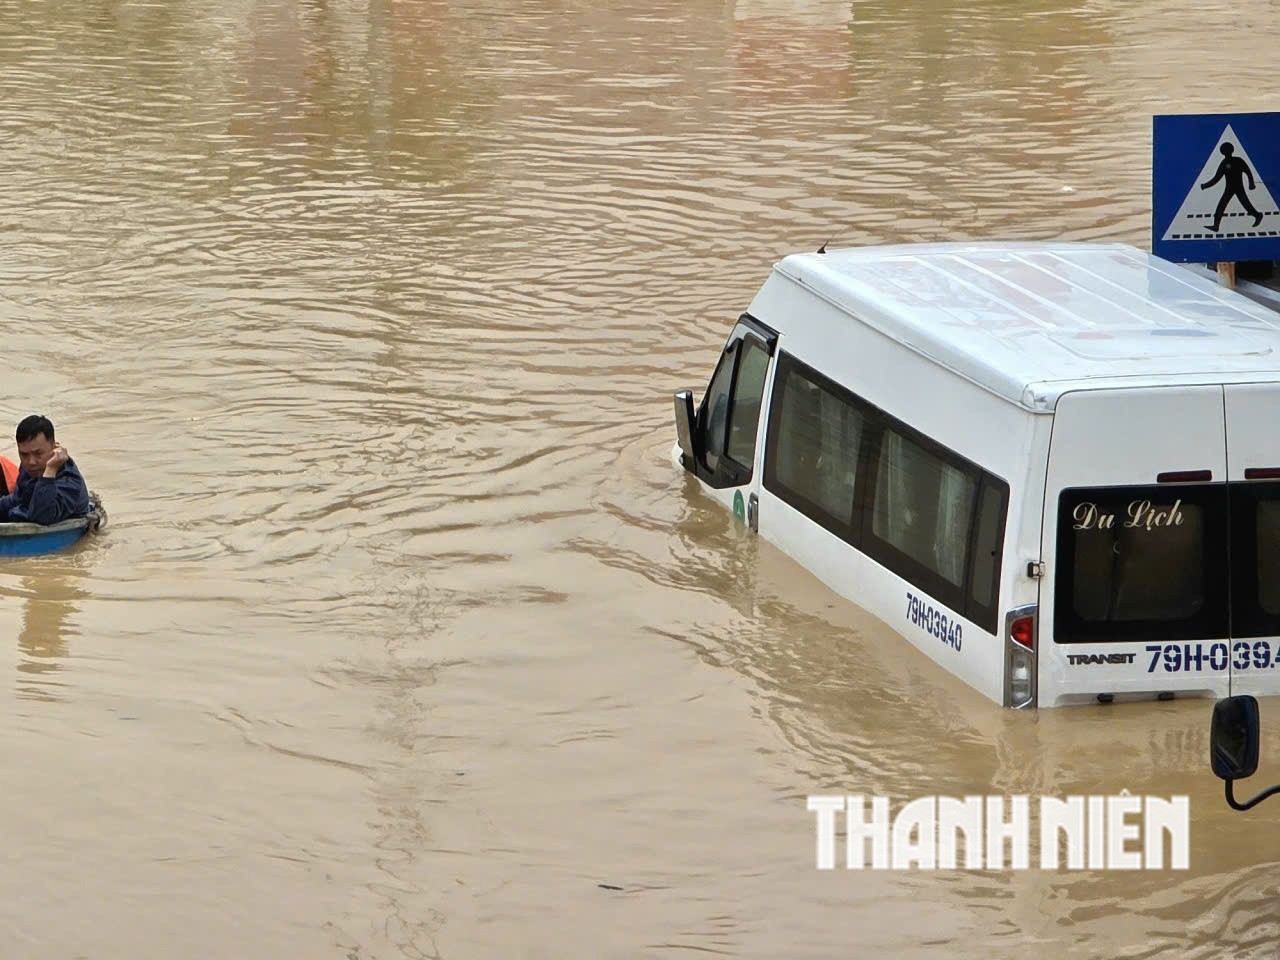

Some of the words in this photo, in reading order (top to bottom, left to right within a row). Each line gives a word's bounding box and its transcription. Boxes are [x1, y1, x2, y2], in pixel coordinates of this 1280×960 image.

[1072, 502, 1115, 530] Du
[1123, 499, 1184, 531] Lịch
[1066, 652, 1137, 666] TRANSIT
